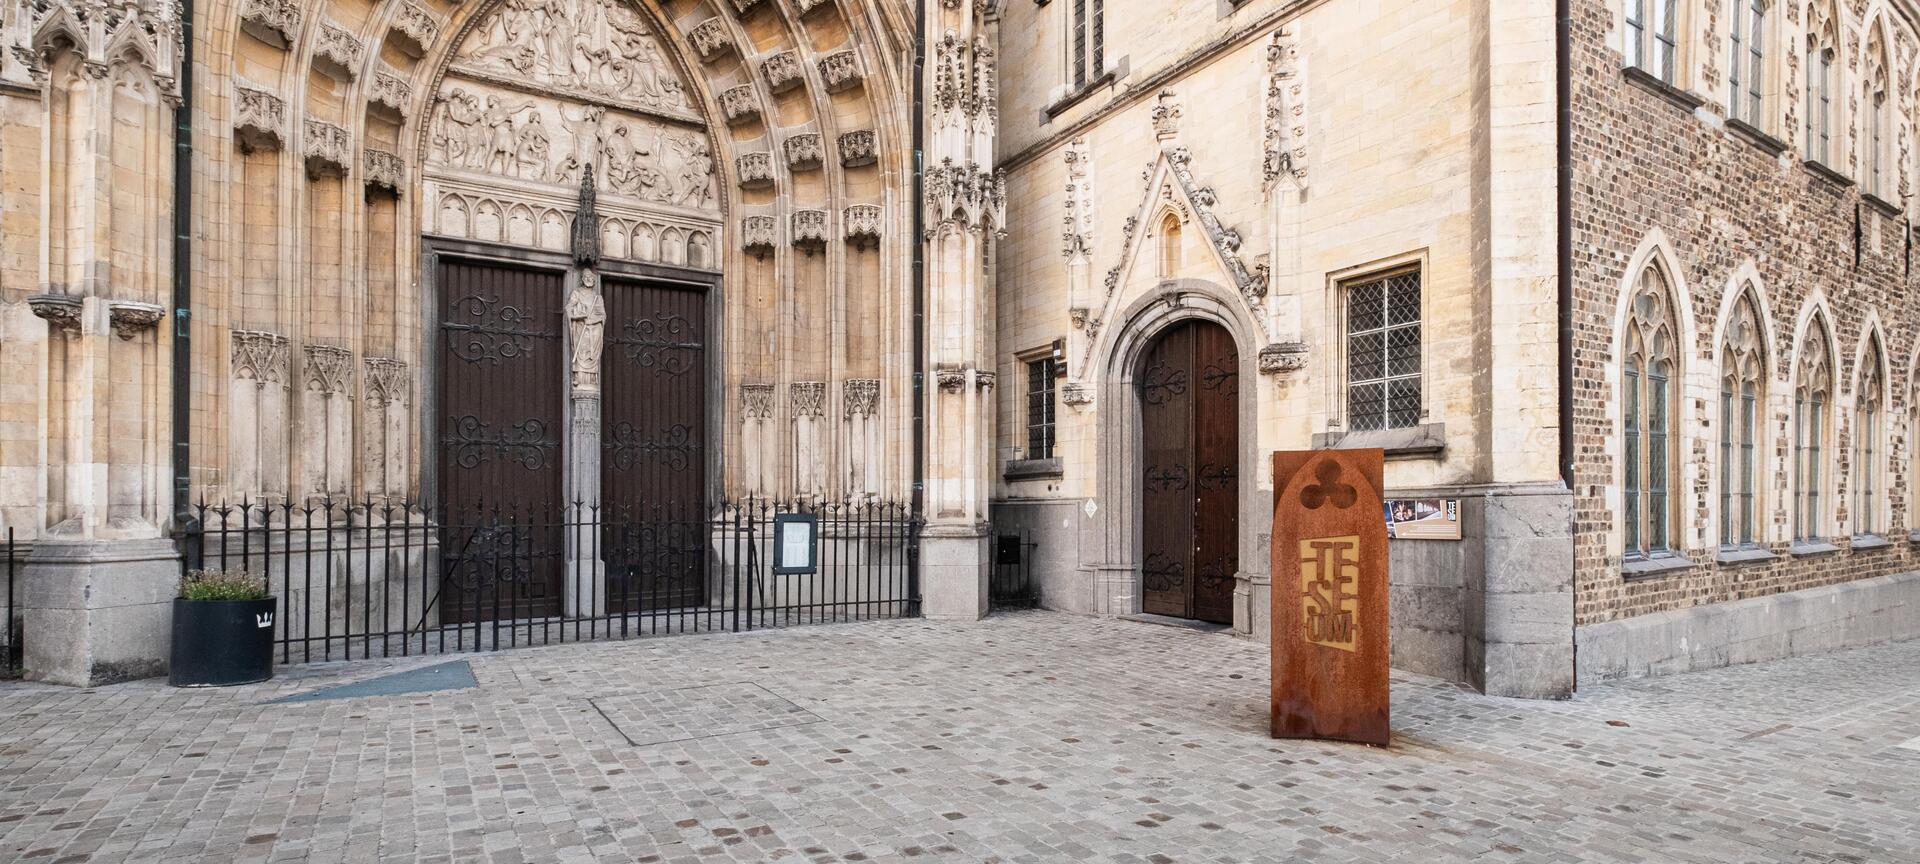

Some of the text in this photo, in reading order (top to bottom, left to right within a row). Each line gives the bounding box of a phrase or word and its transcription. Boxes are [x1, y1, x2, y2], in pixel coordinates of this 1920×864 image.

[1310, 541, 1354, 581] TE
[1307, 578, 1353, 615] SE
[1306, 613, 1353, 643] UM
